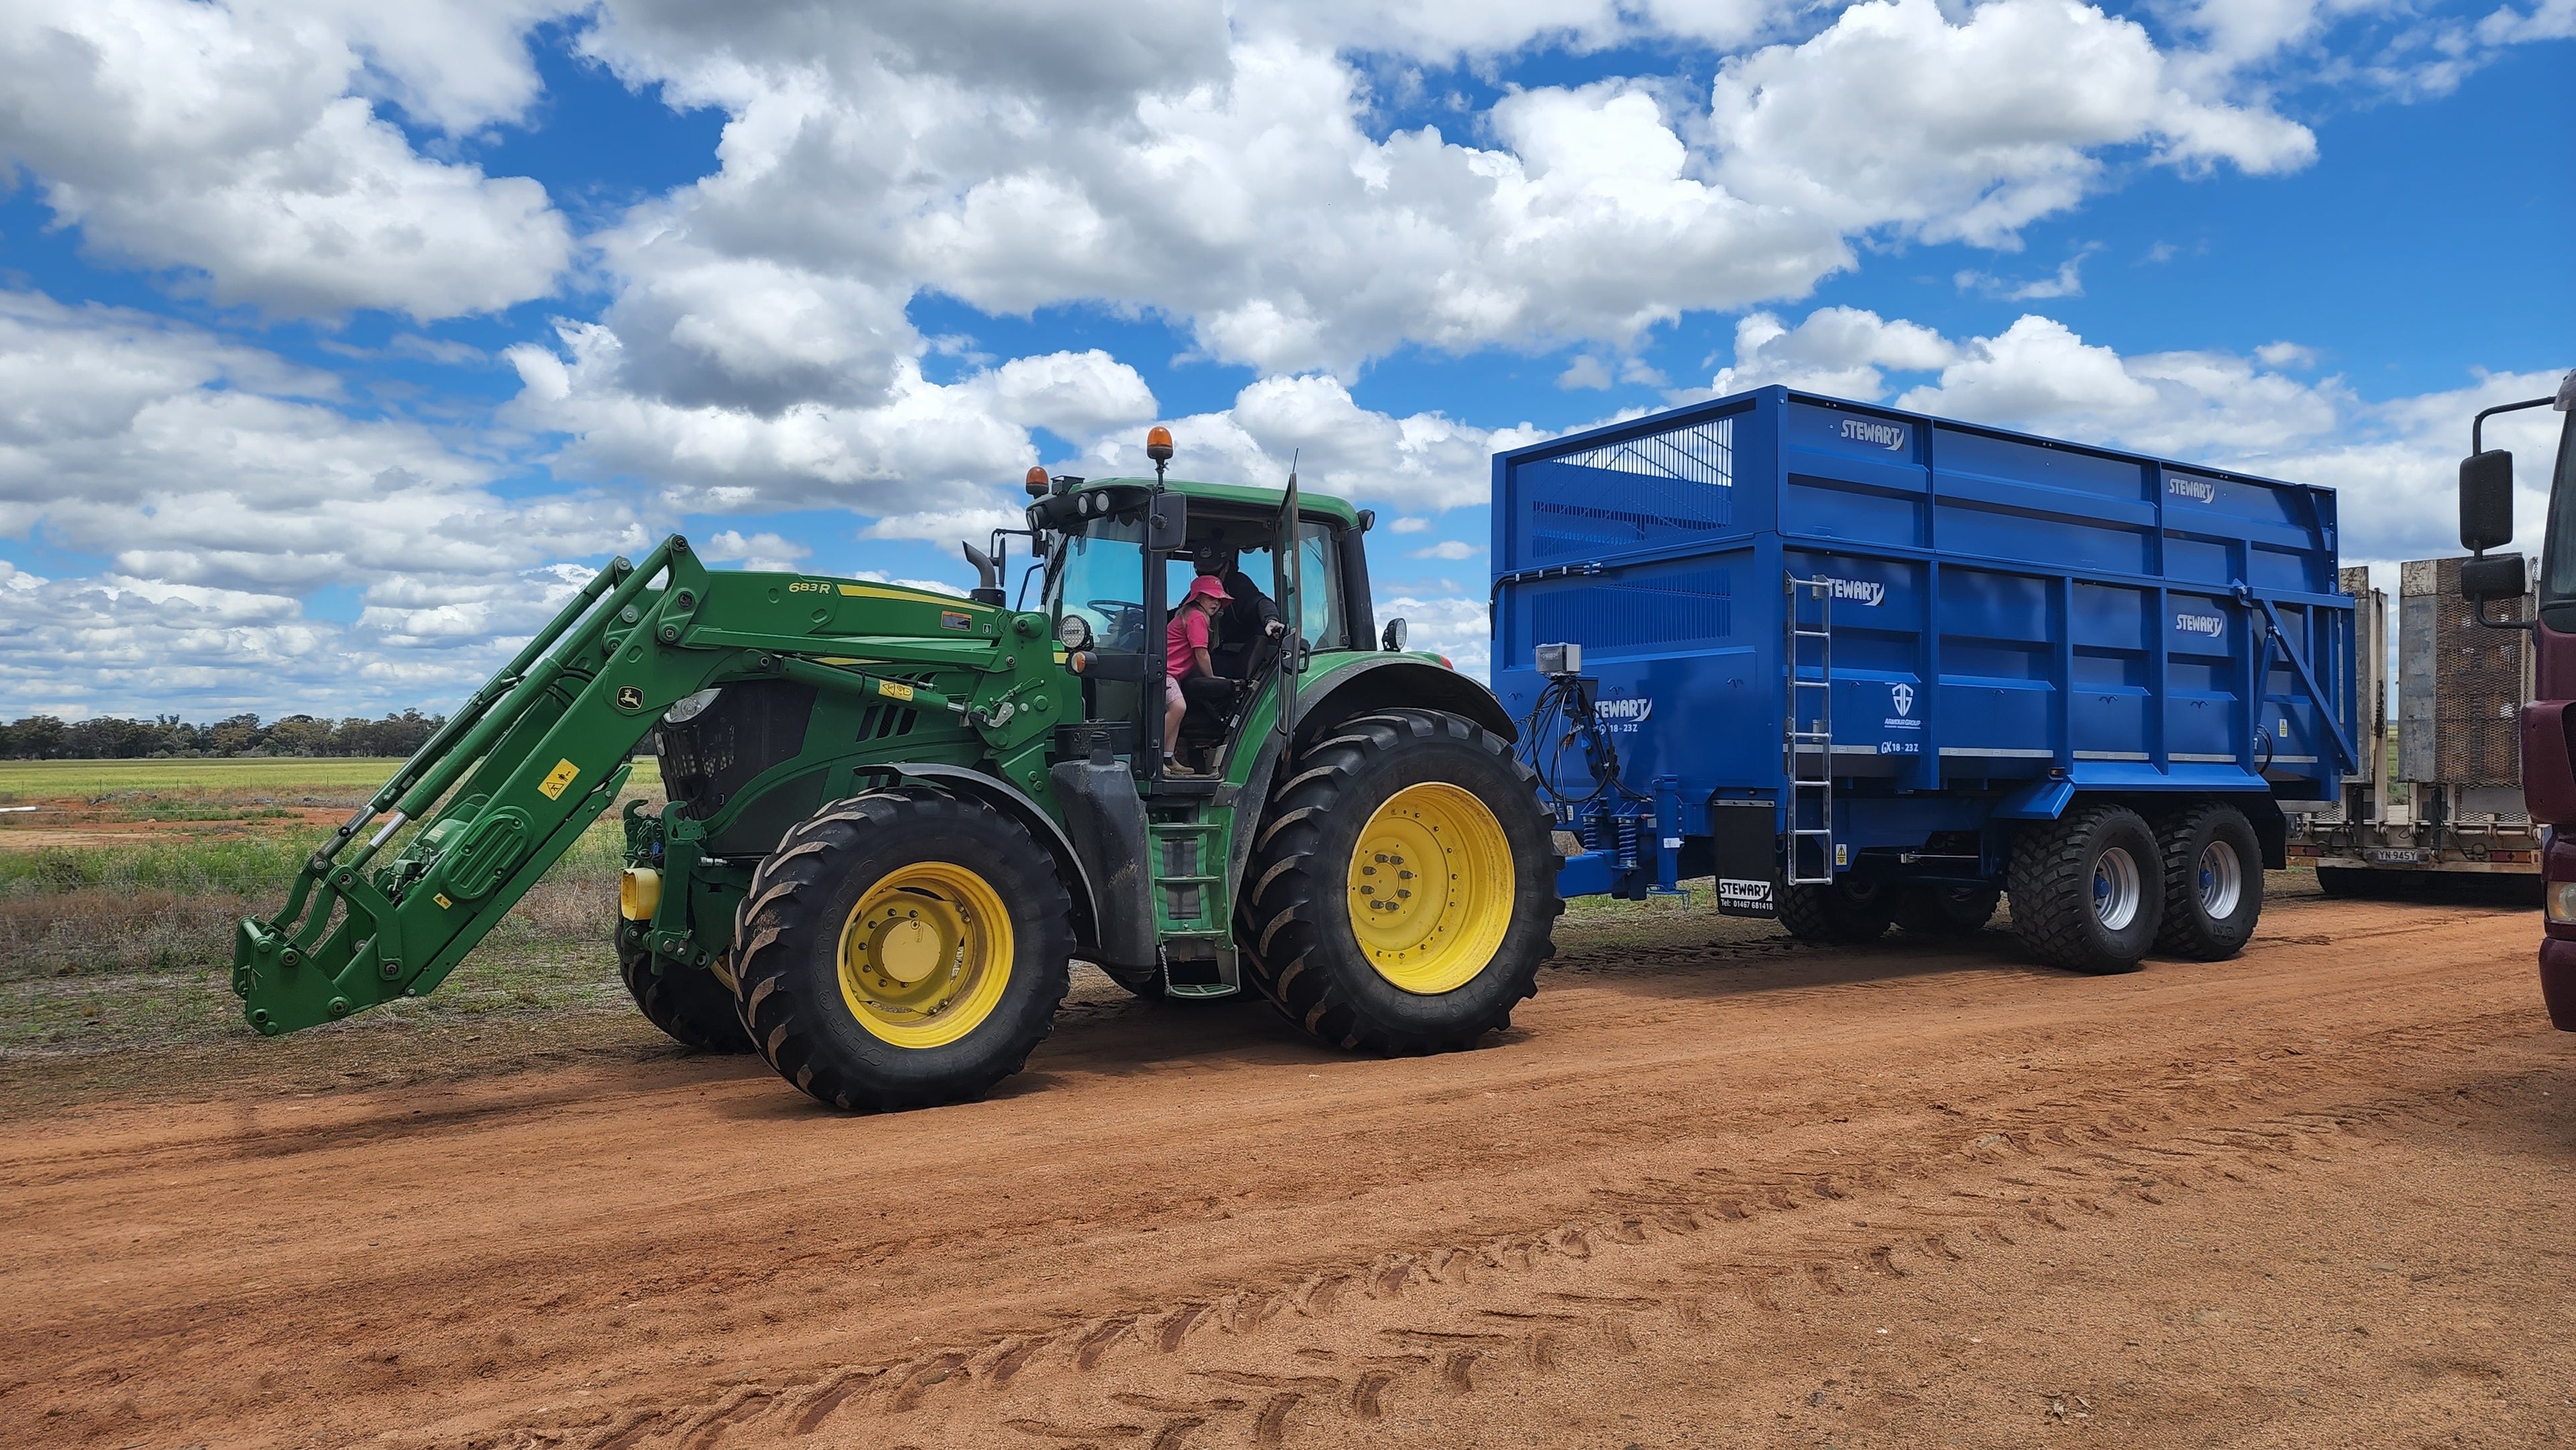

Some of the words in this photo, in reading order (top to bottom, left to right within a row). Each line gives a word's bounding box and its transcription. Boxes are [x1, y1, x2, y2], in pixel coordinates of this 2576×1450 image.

[1841, 419, 1904, 451] STEWART
[2169, 478, 2215, 504] STEWART
[788, 582, 830, 594] 683R
[1827, 578, 1885, 606] TEWART
[2176, 614, 2223, 637] STEWART
[1595, 698, 1652, 722] TEWART
[1719, 882, 1772, 901] STEWART
[1721, 899, 1731, 907] Tel:
[1733, 900, 1750, 909] 01467
[1752, 901, 1773, 911] 681418
